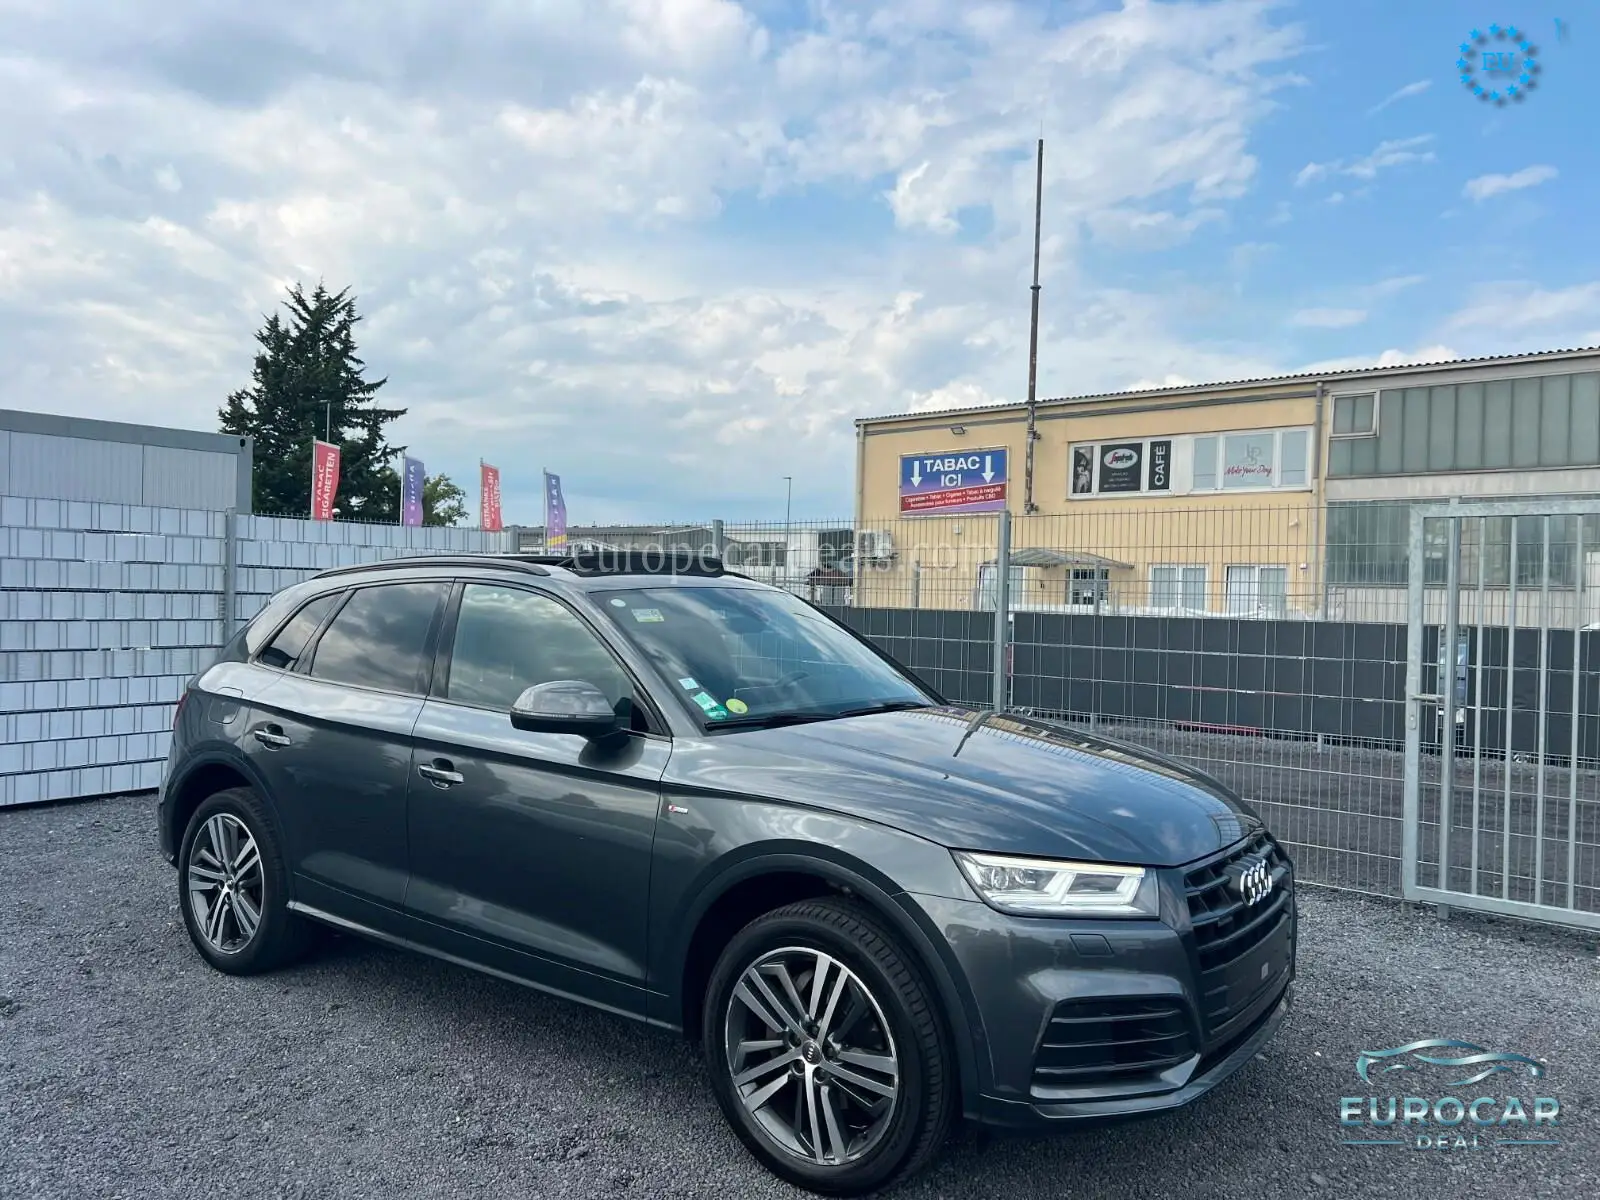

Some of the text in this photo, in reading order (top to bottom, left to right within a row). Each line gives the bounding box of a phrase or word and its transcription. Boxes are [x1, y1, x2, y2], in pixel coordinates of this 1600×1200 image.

[923, 455, 981, 473] TABAC
[1257, 464, 1273, 477] Day
[316, 464, 325, 502] TABAC
[321, 452, 336, 519] ZIGARETTEN
[940, 473, 962, 488] ICI
